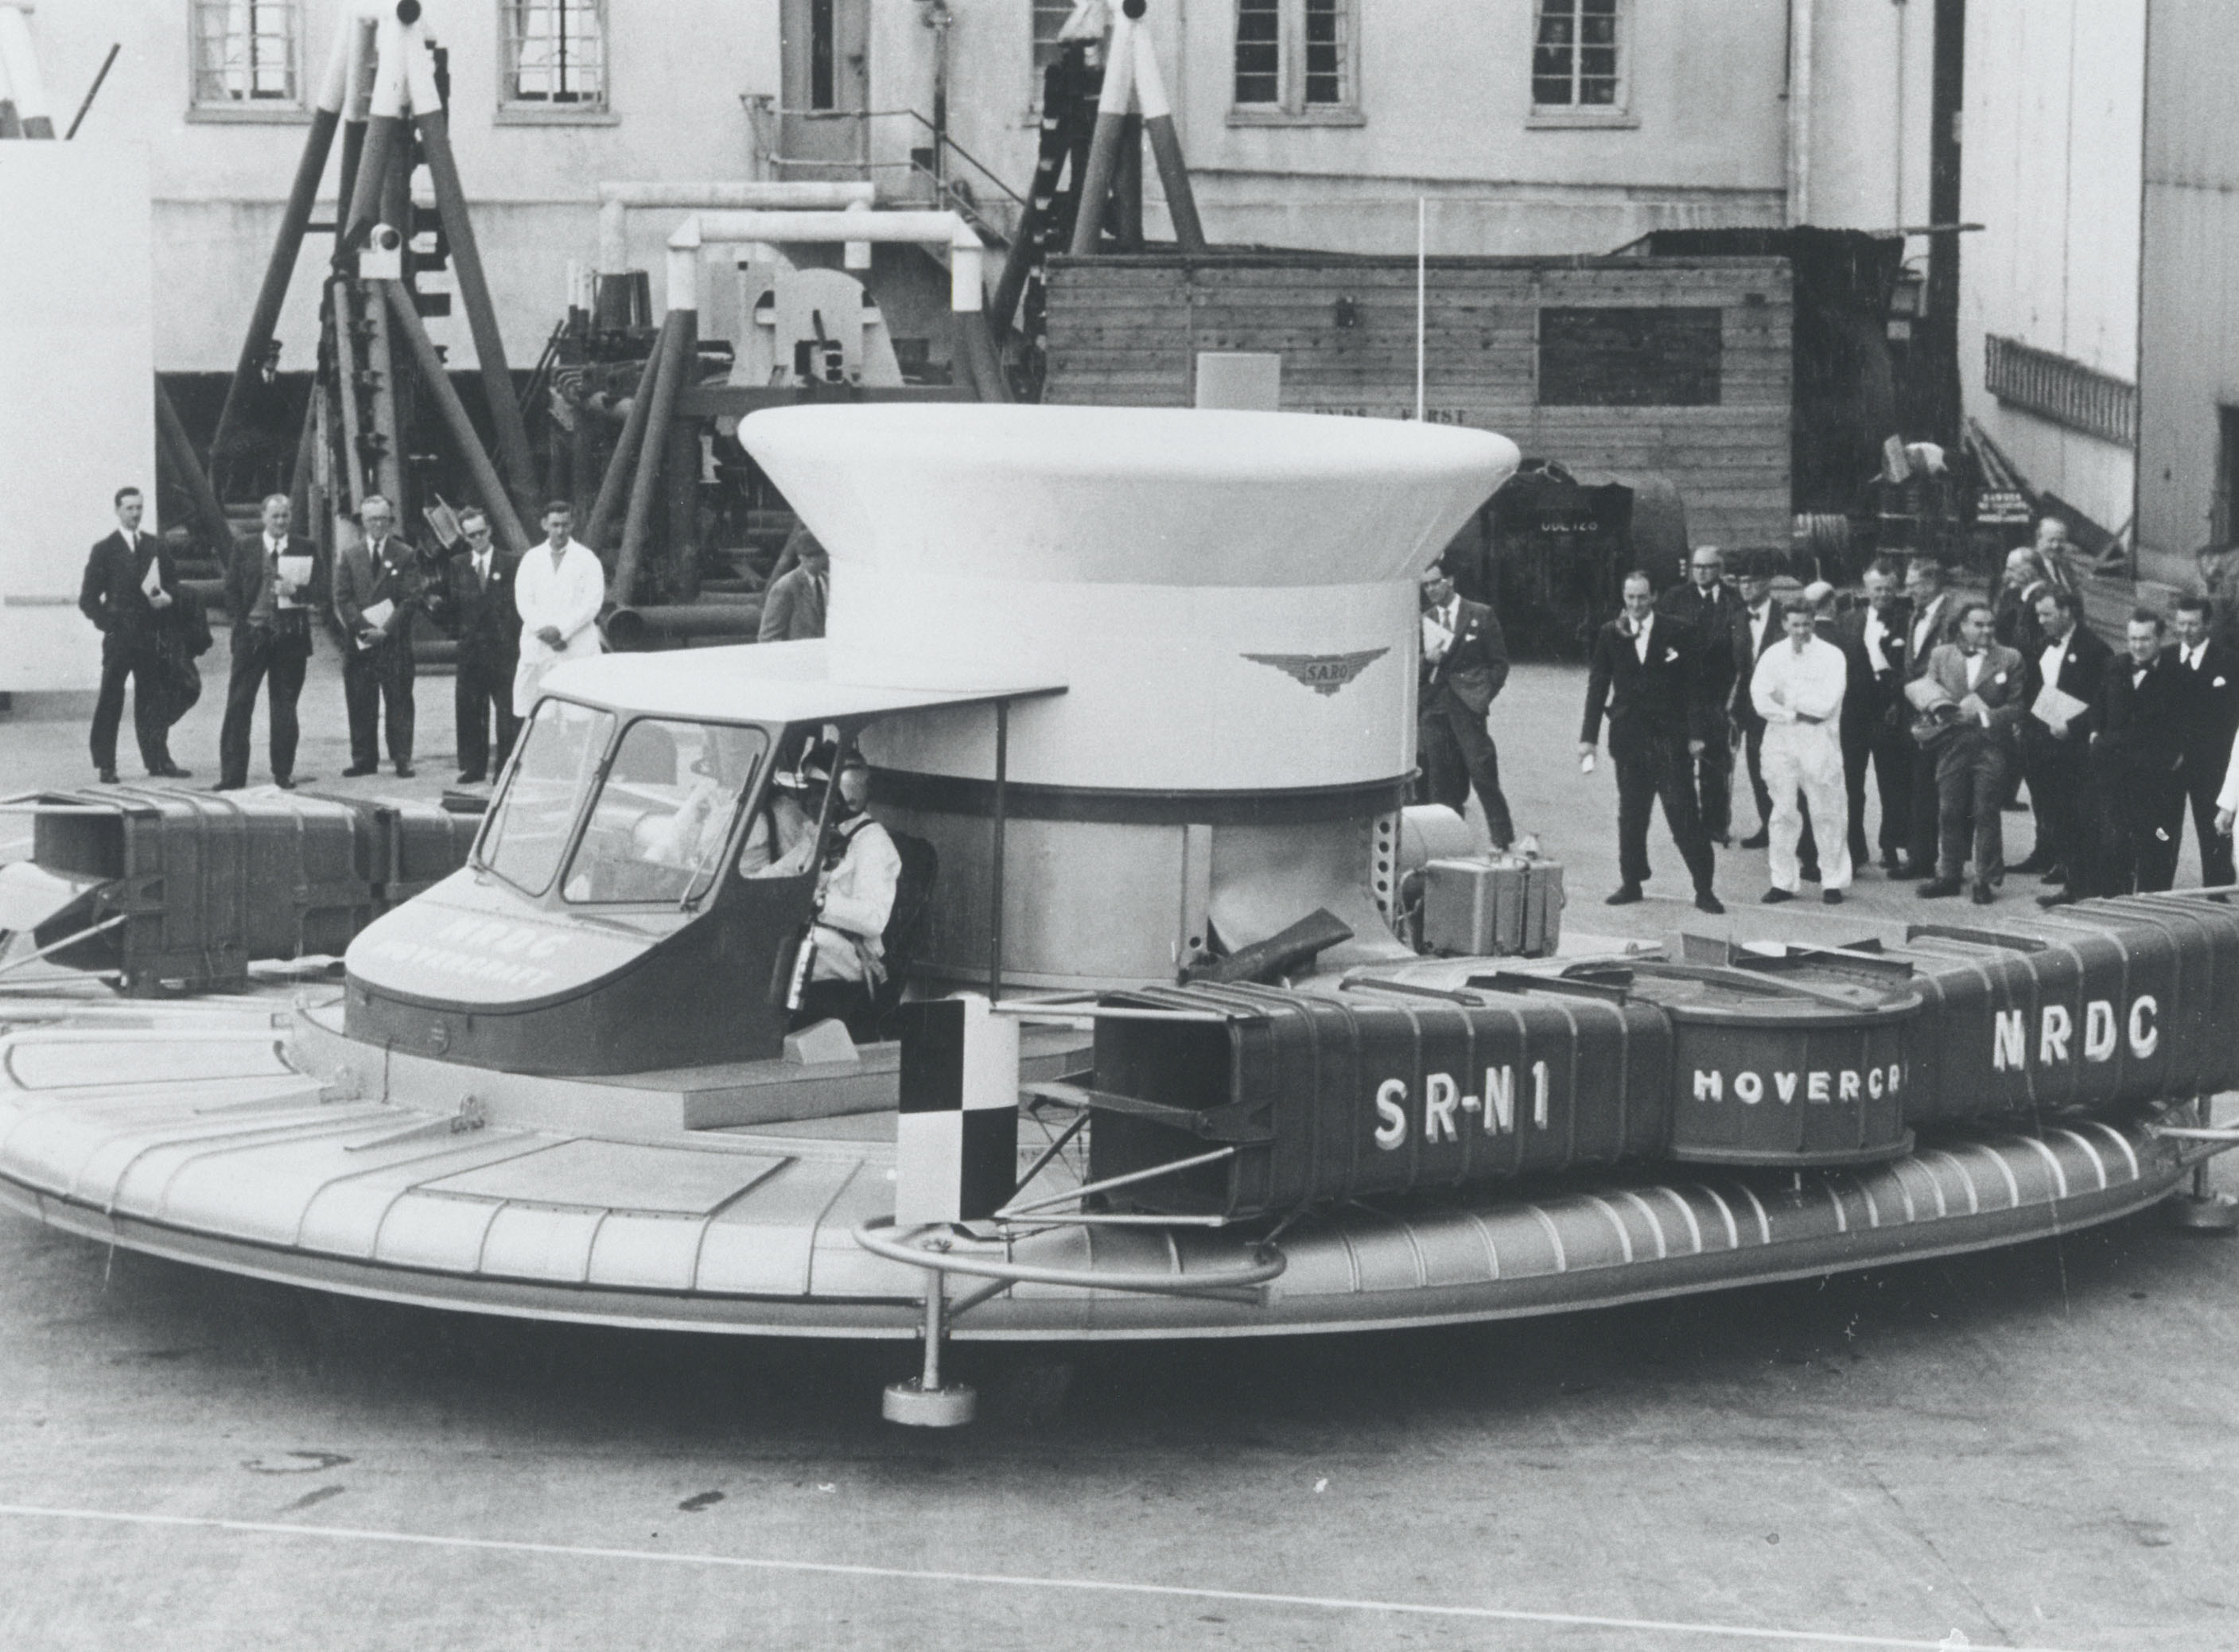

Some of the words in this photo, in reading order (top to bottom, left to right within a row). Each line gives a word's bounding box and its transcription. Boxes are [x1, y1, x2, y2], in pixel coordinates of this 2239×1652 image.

[1401, 408, 1467, 426] FRST
[1307, 664, 1348, 680] SARO
[437, 916, 571, 958] NRDC
[1992, 994, 2158, 1073] NRDC
[1693, 1063, 1907, 1104] HOVERCR
